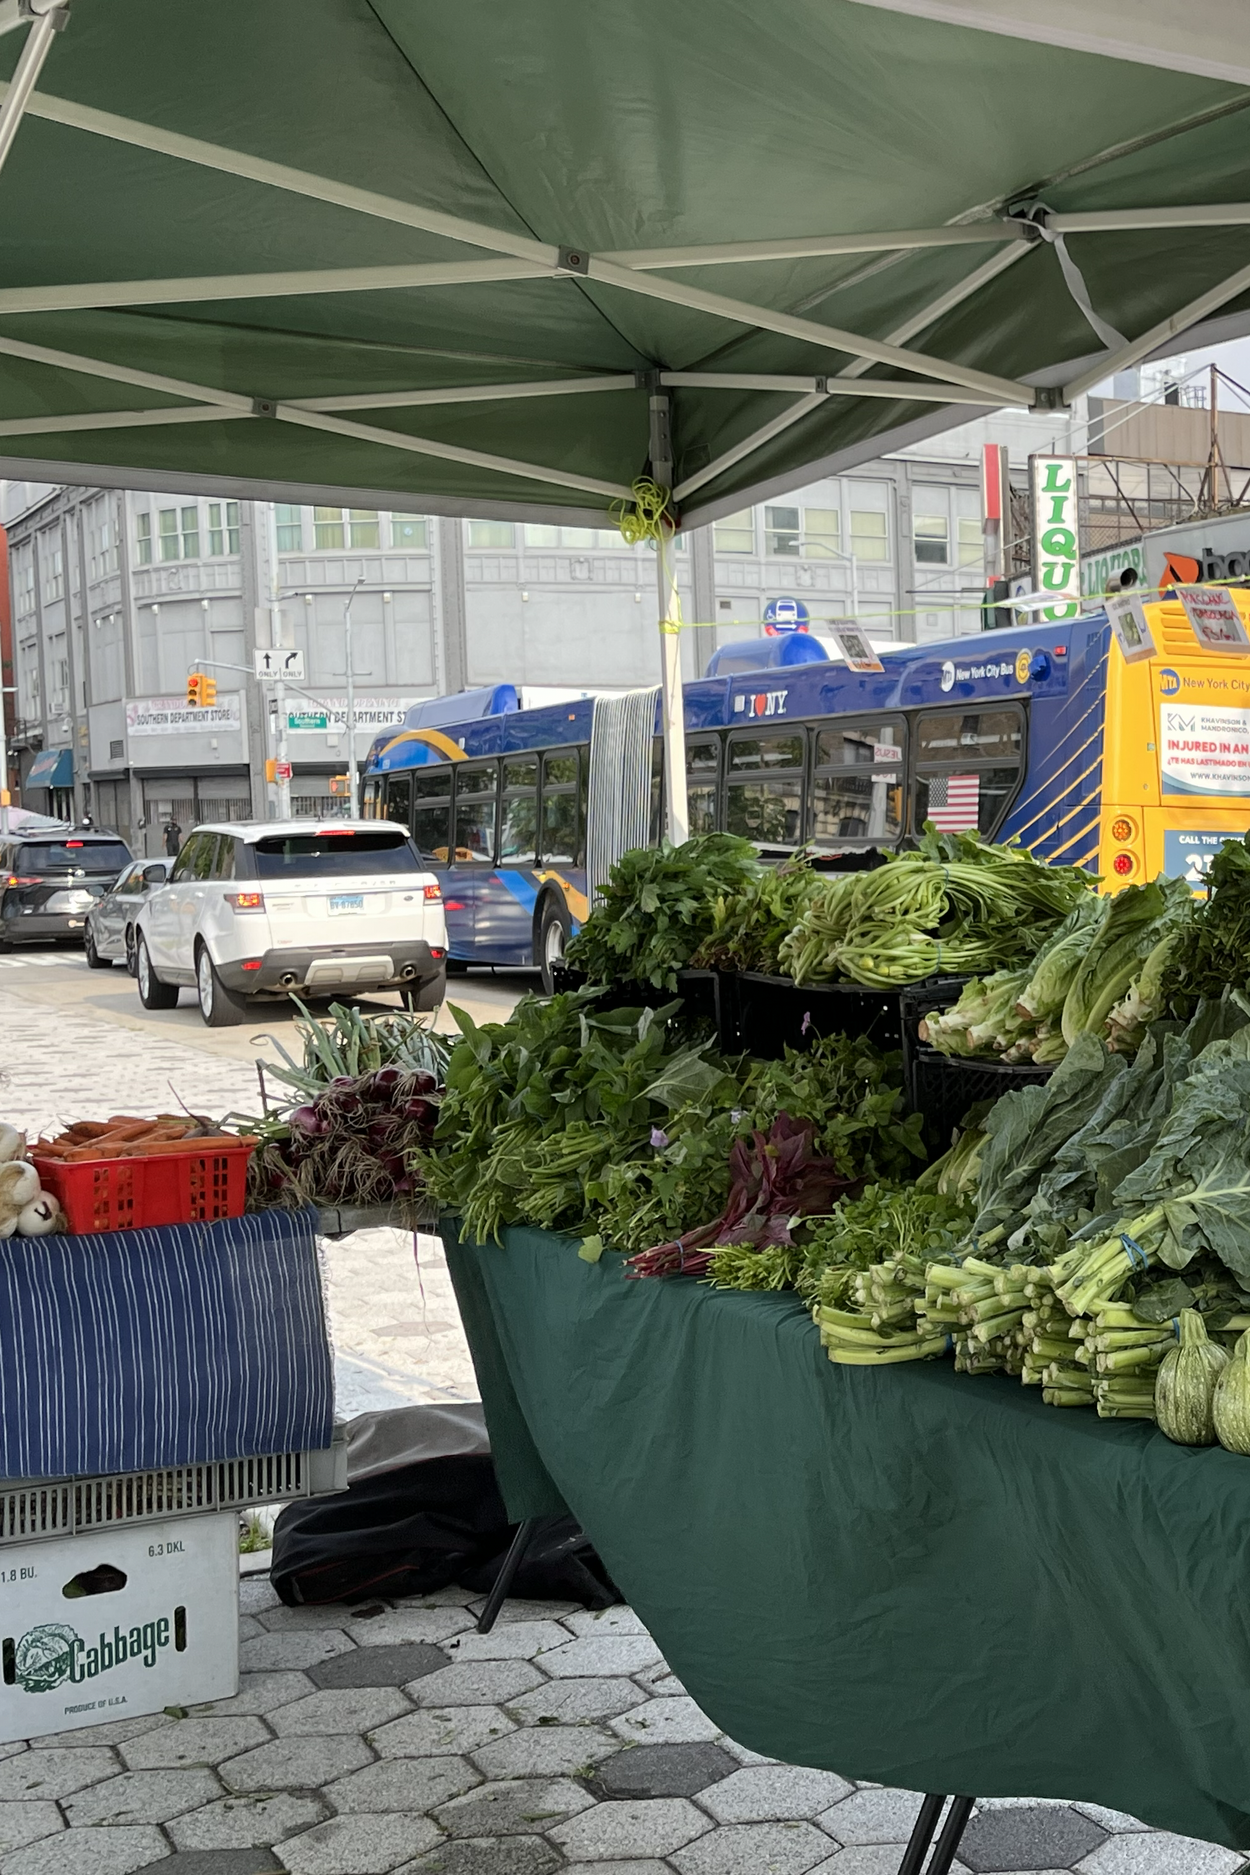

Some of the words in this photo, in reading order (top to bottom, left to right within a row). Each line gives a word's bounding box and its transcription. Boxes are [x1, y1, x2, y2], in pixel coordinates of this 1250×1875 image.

[956, 668, 970, 681] New
[971, 666, 985, 678] York
[986, 665, 1000, 678] City
[1001, 663, 1013, 675] Bus
[1183, 677, 1204, 688] New
[1207, 678, 1229, 690] York
[1231, 679, 1250, 692] City
[137, 712, 168, 725] SOUTHERN
[170, 710, 209, 723] DEPARTMENT
[210, 708, 230, 721] STORE
[335, 711, 394, 724] DEARTMENT
[1201, 717, 1240, 726] KHAVINSON
[1168, 740, 1217, 752] INJURED
[1220, 743, 1231, 753] IN
[1233, 744, 1249, 754] AN
[1181, 757, 1195, 765] HAS
[1196, 758, 1236, 768] LASTIMADO
[1238, 760, 1247, 768] EN
[1179, 835, 1200, 844] CALL
[1202, 836, 1218, 845] THE
[148, 1545, 164, 1557] 6.3
[167, 1541, 186, 1554] DKL
[1, 1569, 17, 1583] 1.8
[20, 1566, 38, 1579] BU.
[69, 1617, 170, 1684] Cabbage
[65, 1702, 96, 1715] PRODUCE
[98, 1699, 106, 1708] OF
